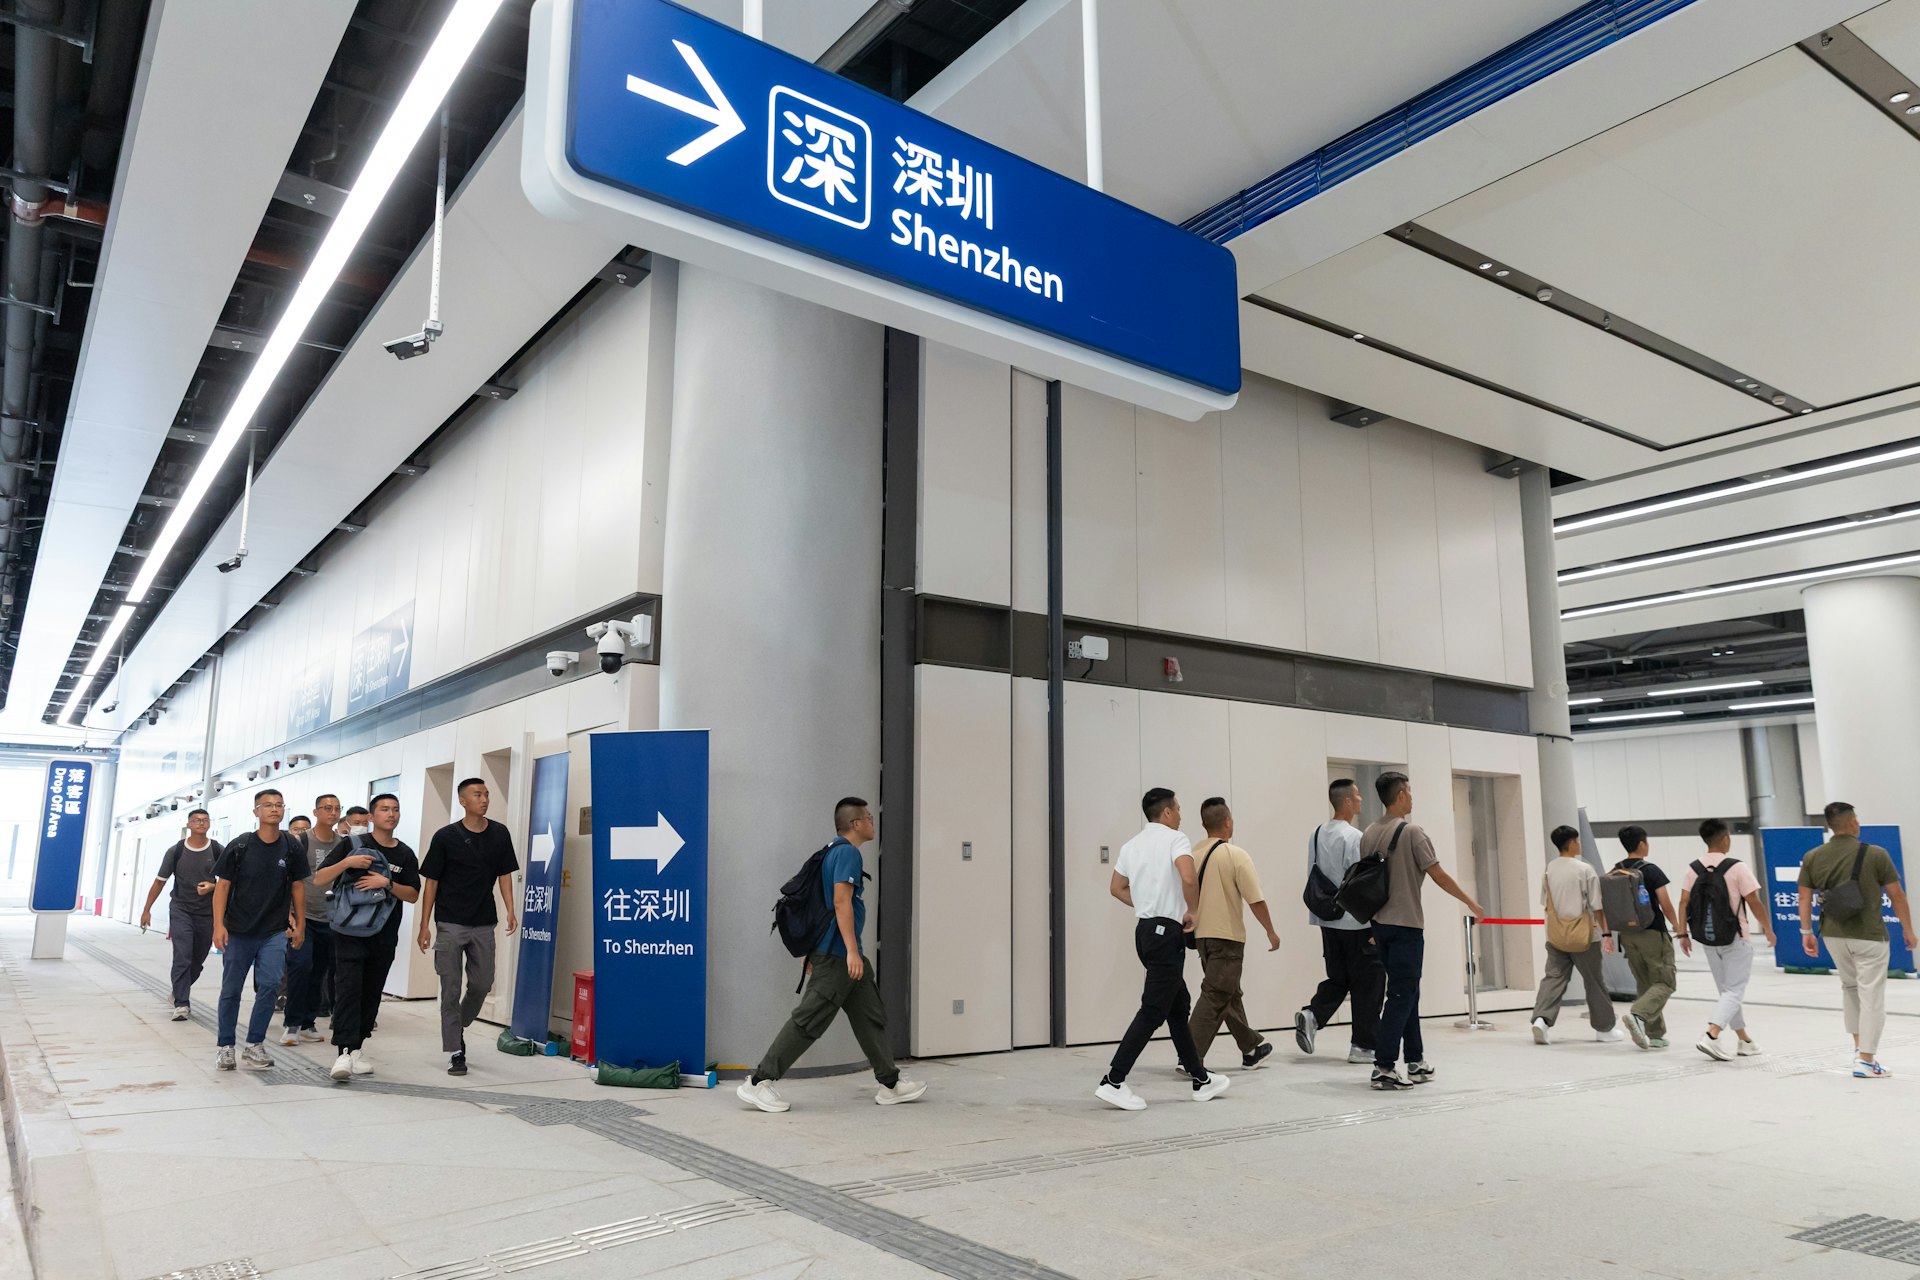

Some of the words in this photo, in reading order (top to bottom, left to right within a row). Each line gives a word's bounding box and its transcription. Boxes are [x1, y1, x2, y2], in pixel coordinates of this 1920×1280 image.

[781, 110, 858, 206] 深
[891, 135, 993, 231] 深圳
[890, 208, 1063, 303] Shenzhen
[50, 767, 67, 794] Drop
[50, 794, 63, 813] Off
[47, 812, 61, 838] Area
[525, 885, 554, 914] 往深圳
[603, 887, 690, 923] 往深圳
[1776, 912, 1788, 921] To
[522, 926, 529, 940] To
[528, 927, 552, 942] Shenzhen
[603, 938, 622, 954] To
[624, 938, 694, 956] Shenzhen
